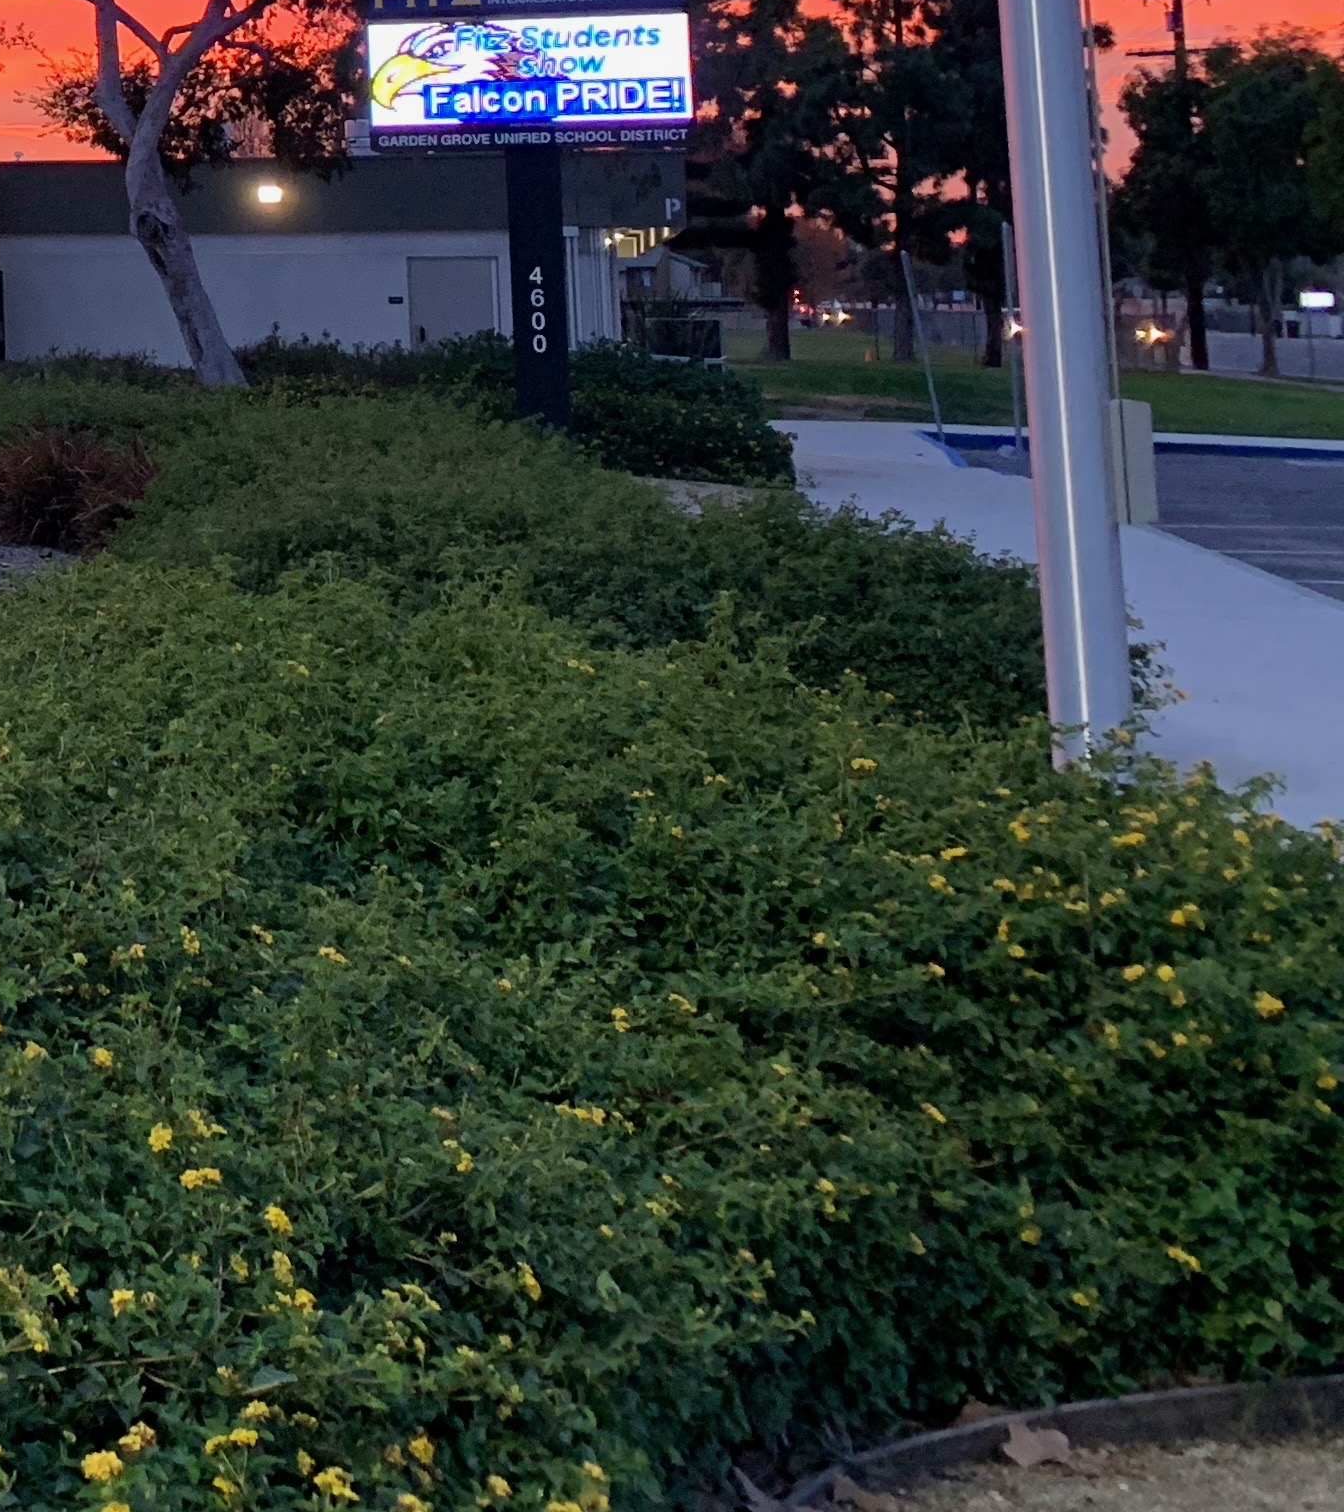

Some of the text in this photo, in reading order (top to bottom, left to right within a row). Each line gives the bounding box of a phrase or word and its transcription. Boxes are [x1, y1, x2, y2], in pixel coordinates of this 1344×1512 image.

[453, 24, 662, 51] Fitz Students
[430, 79, 681, 114] Falcon PRIDE!
[378, 128, 689, 148] GARDEN GROVE UNIFIED SCHOOL DISTRICT
[665, 198, 682, 220] P
[529, 266, 548, 354] 4600
